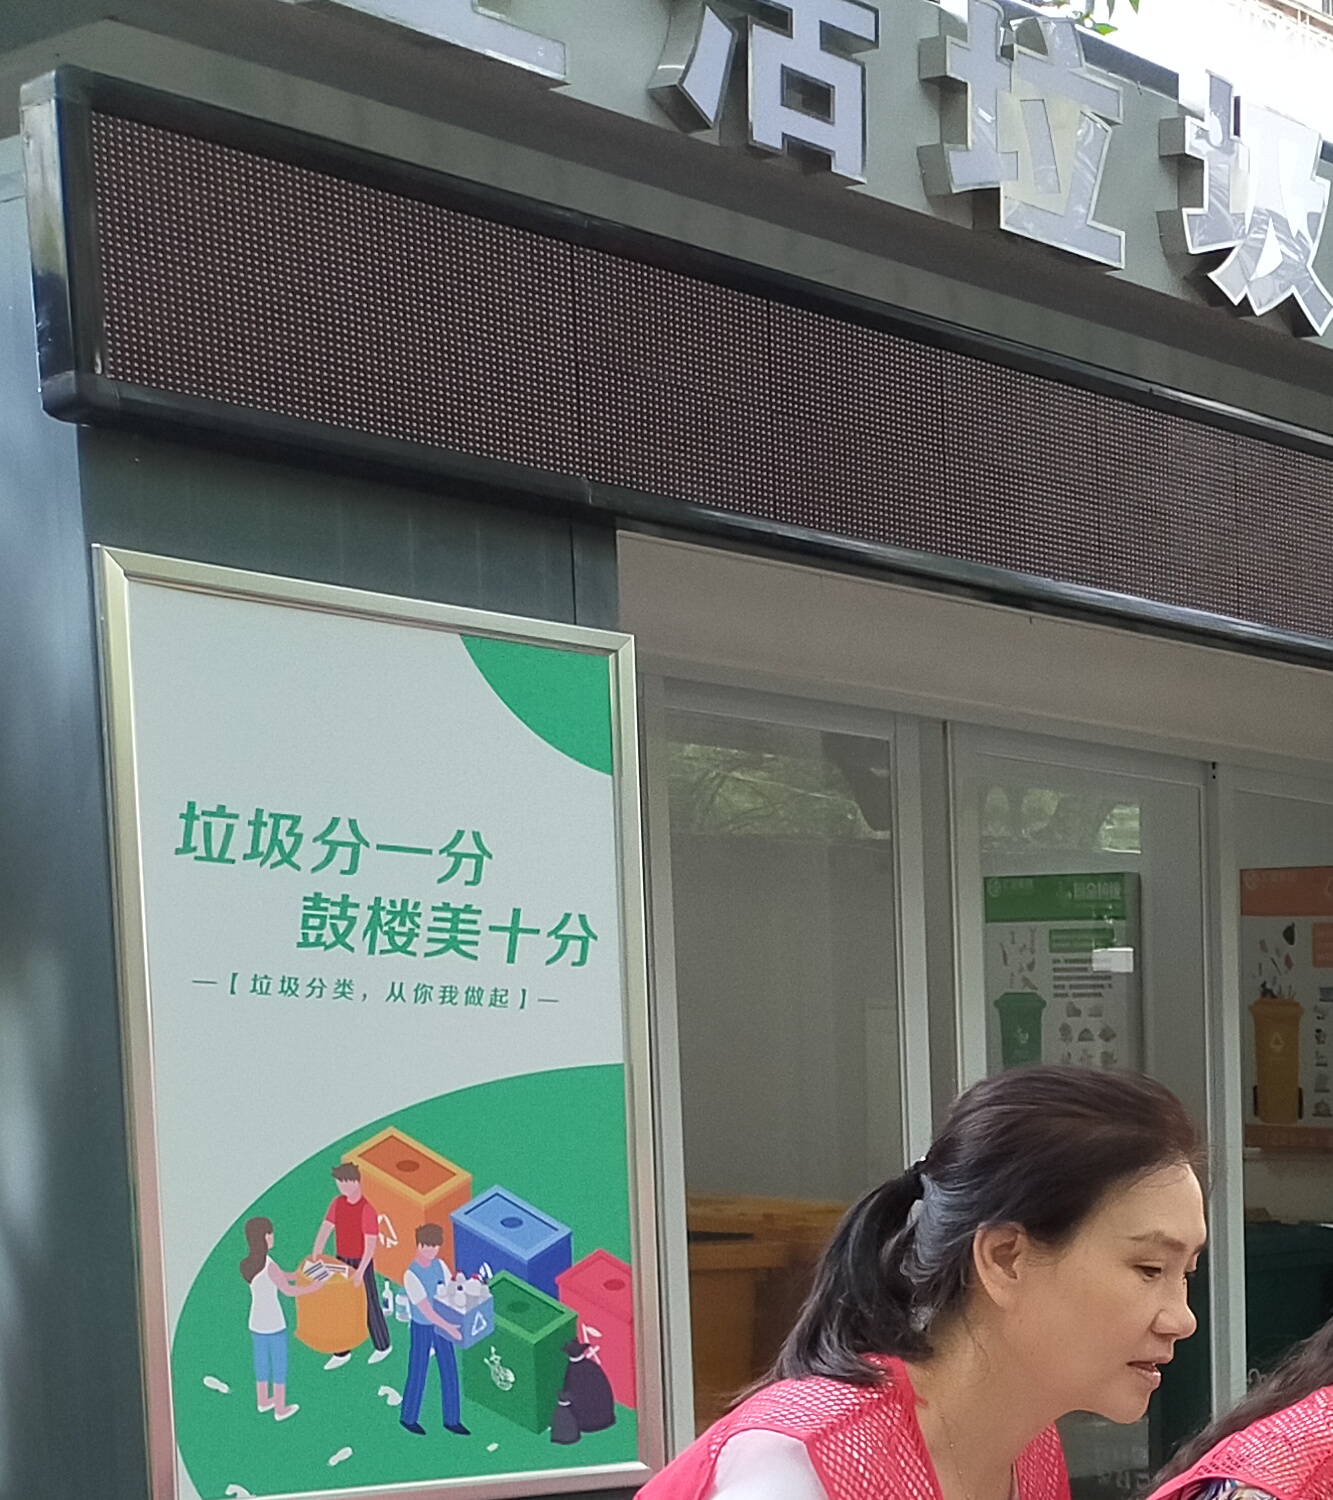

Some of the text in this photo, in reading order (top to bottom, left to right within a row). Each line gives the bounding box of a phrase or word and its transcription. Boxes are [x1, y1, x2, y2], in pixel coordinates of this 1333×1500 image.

[174, 800, 493, 887] 垃圾分一分
[296, 891, 599, 968] 鼓楼美十分
